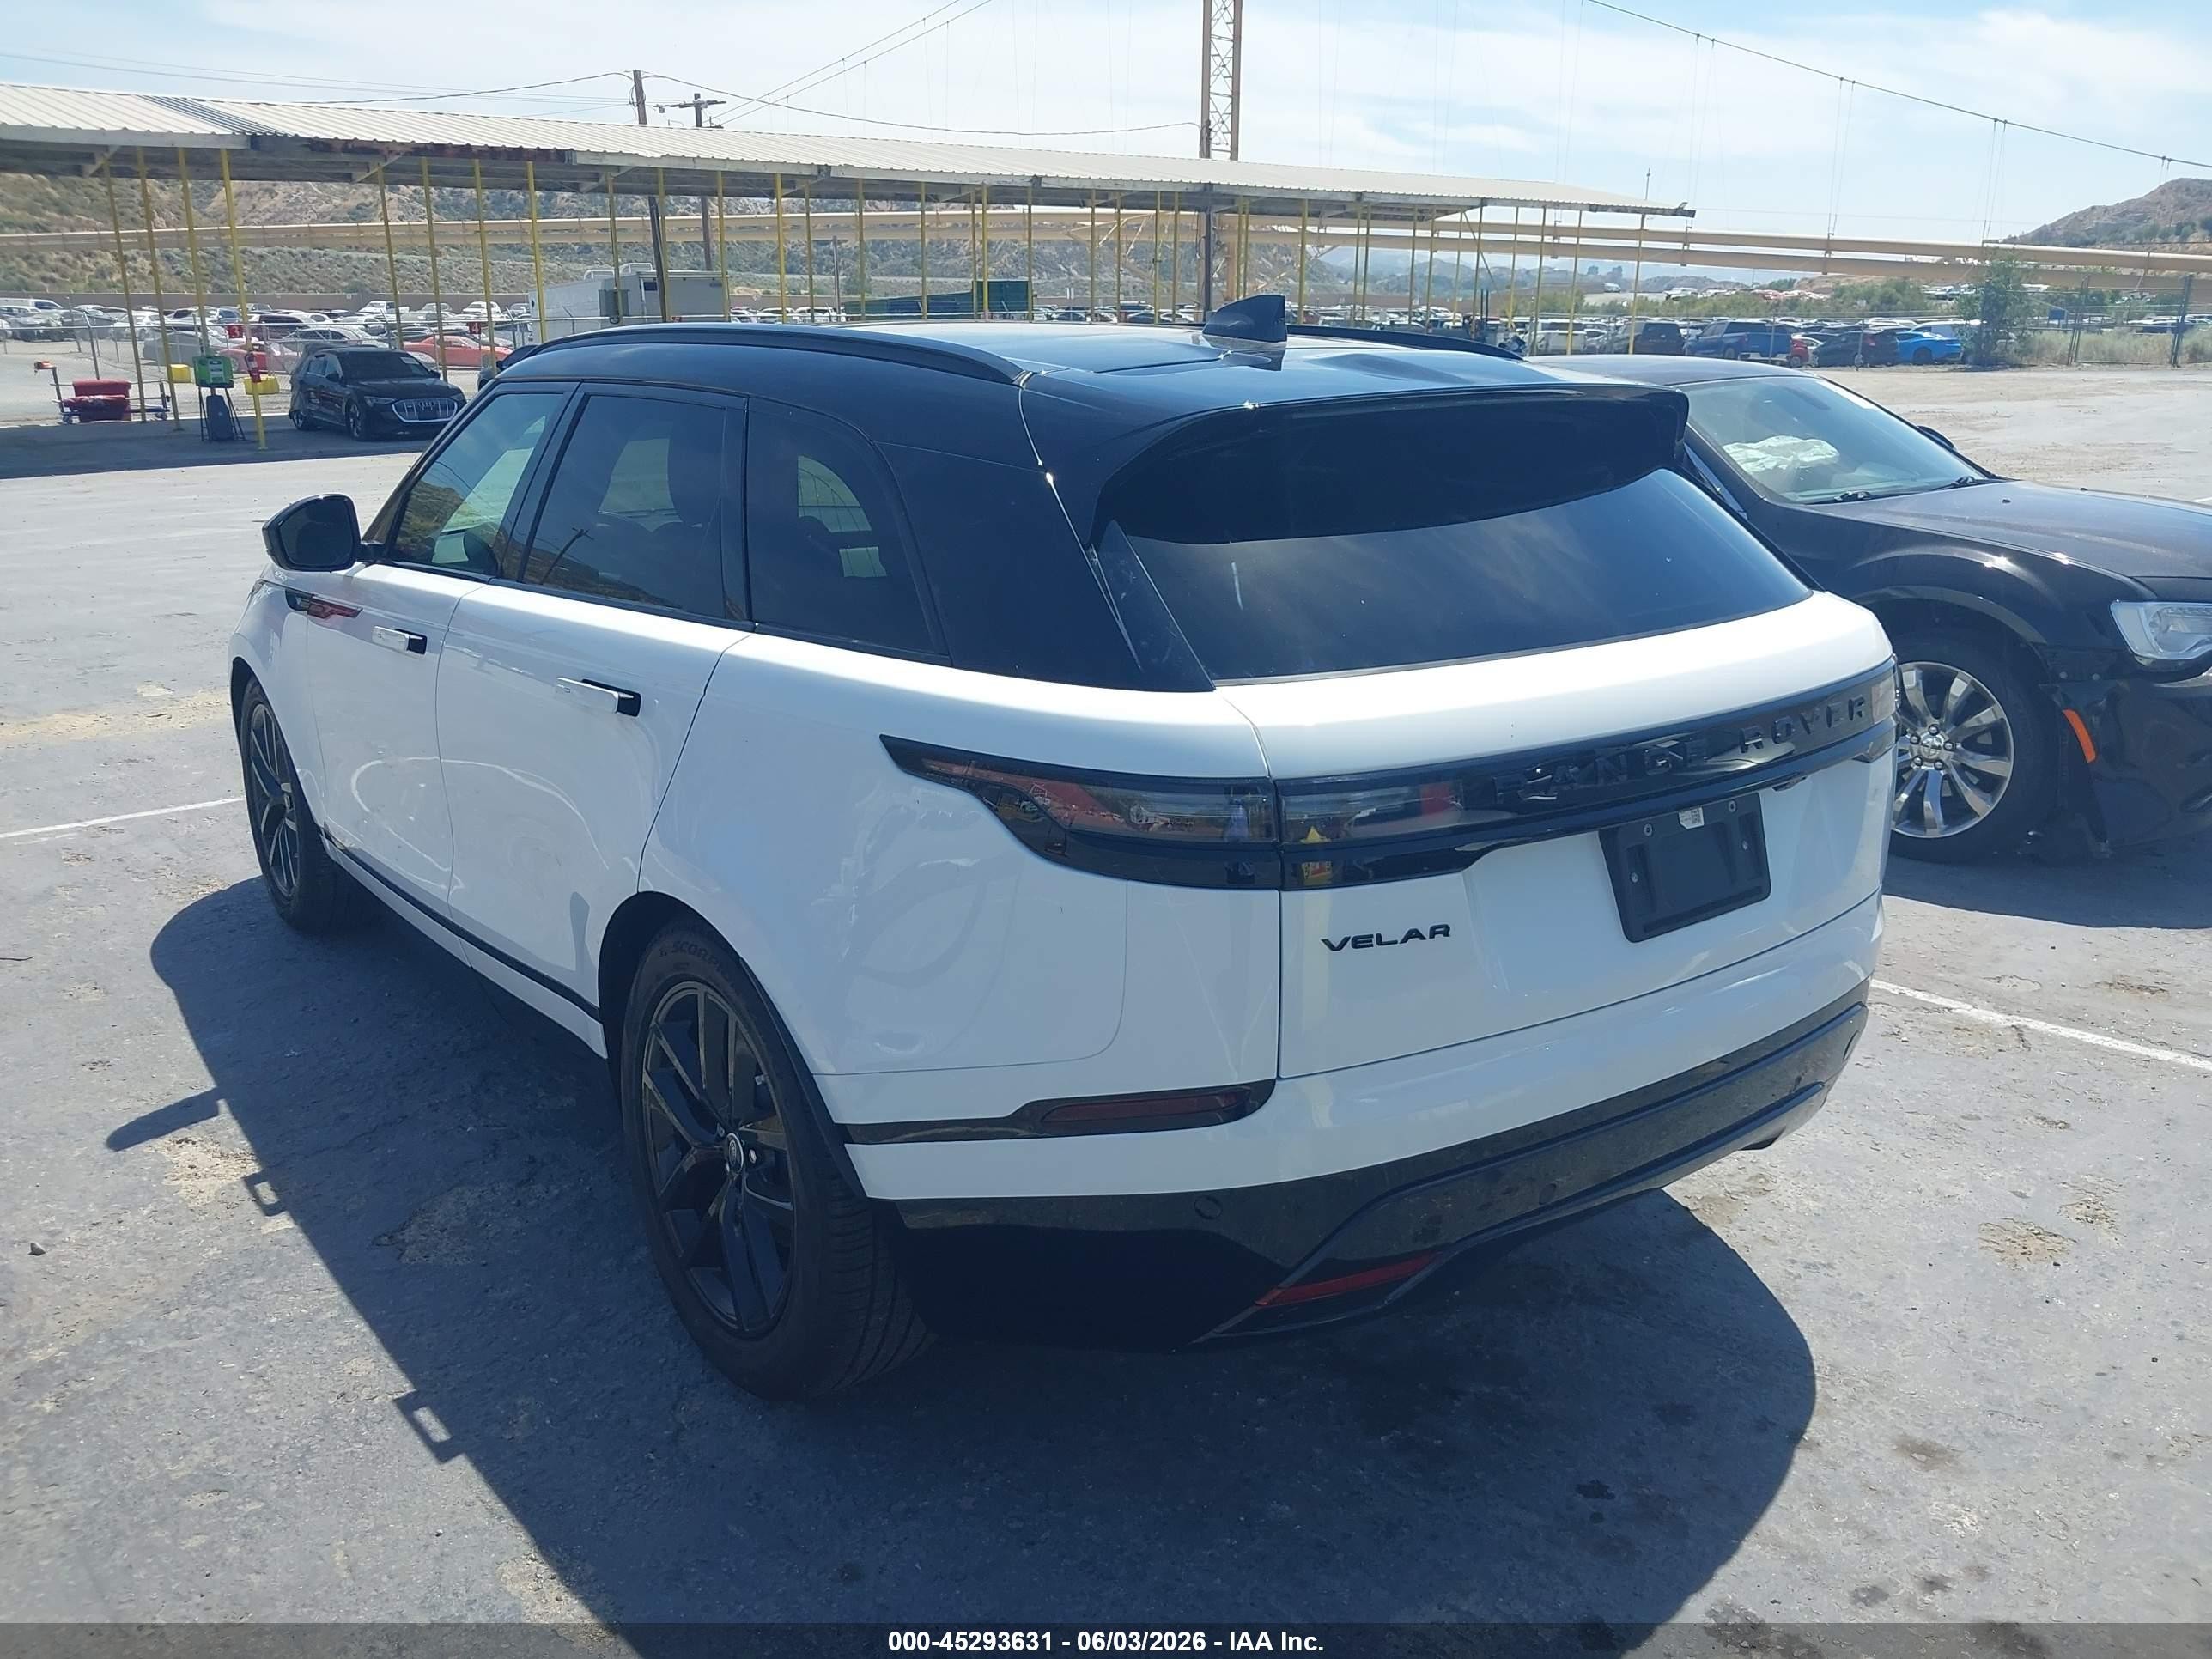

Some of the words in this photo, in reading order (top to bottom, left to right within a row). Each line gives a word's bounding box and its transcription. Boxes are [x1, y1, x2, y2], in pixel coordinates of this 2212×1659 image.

[231, 326, 240, 337] 3
[471, 322, 479, 333] 4
[1738, 694, 1867, 754] ROVER
[1321, 924, 1451, 951] VELAR
